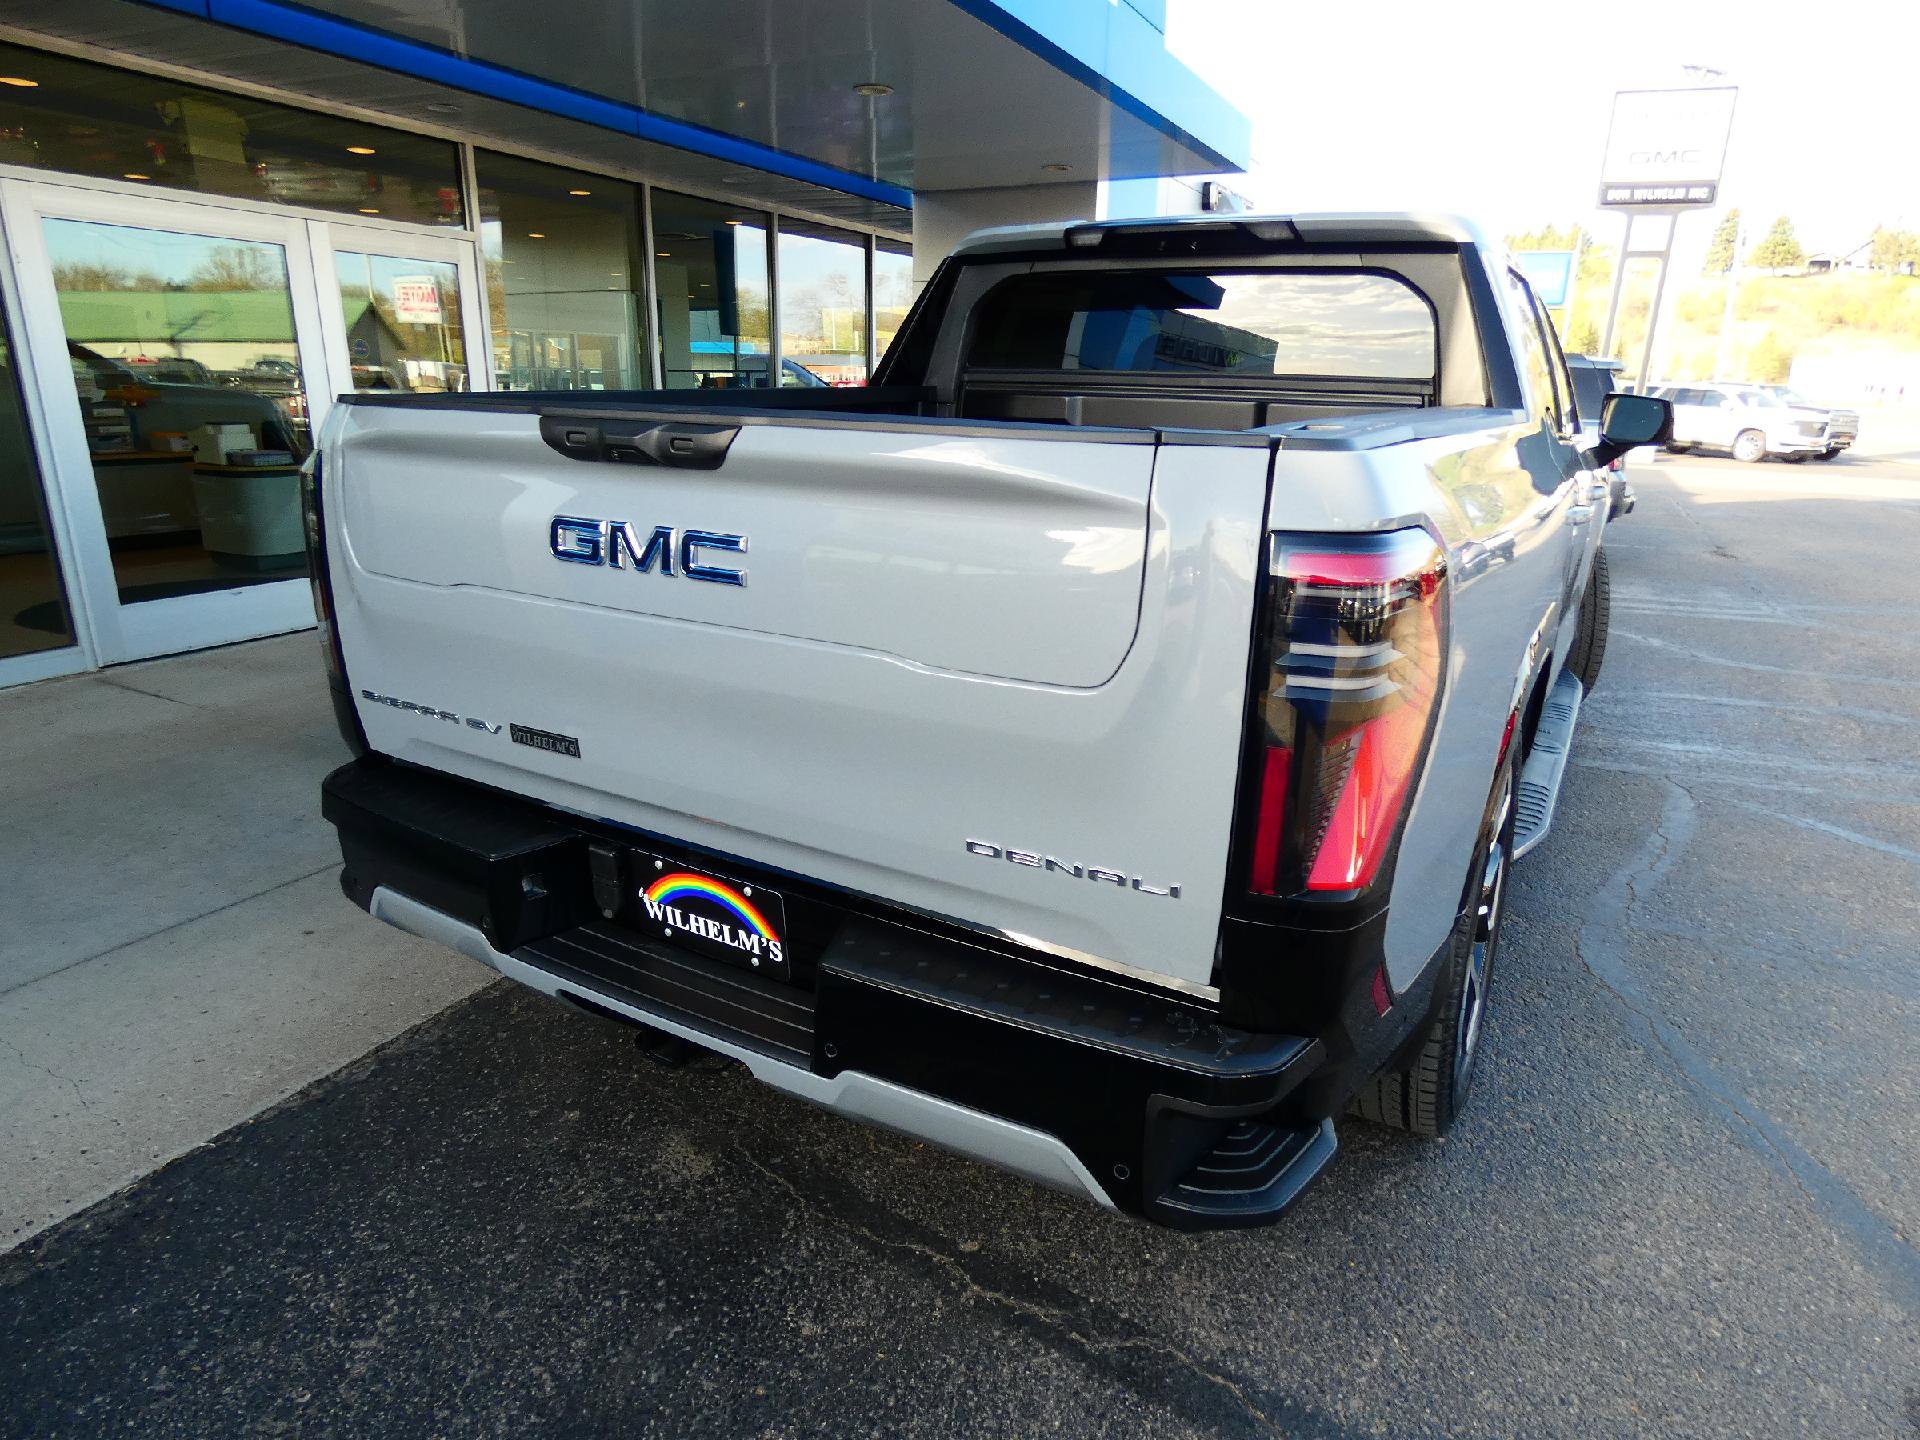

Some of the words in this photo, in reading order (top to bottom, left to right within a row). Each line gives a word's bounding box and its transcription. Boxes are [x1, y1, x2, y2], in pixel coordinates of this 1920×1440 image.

[1629, 149, 1702, 164] GMC
[549, 513, 749, 588] GMC
[465, 717, 503, 735] EV
[965, 837, 1182, 899] DENALI
